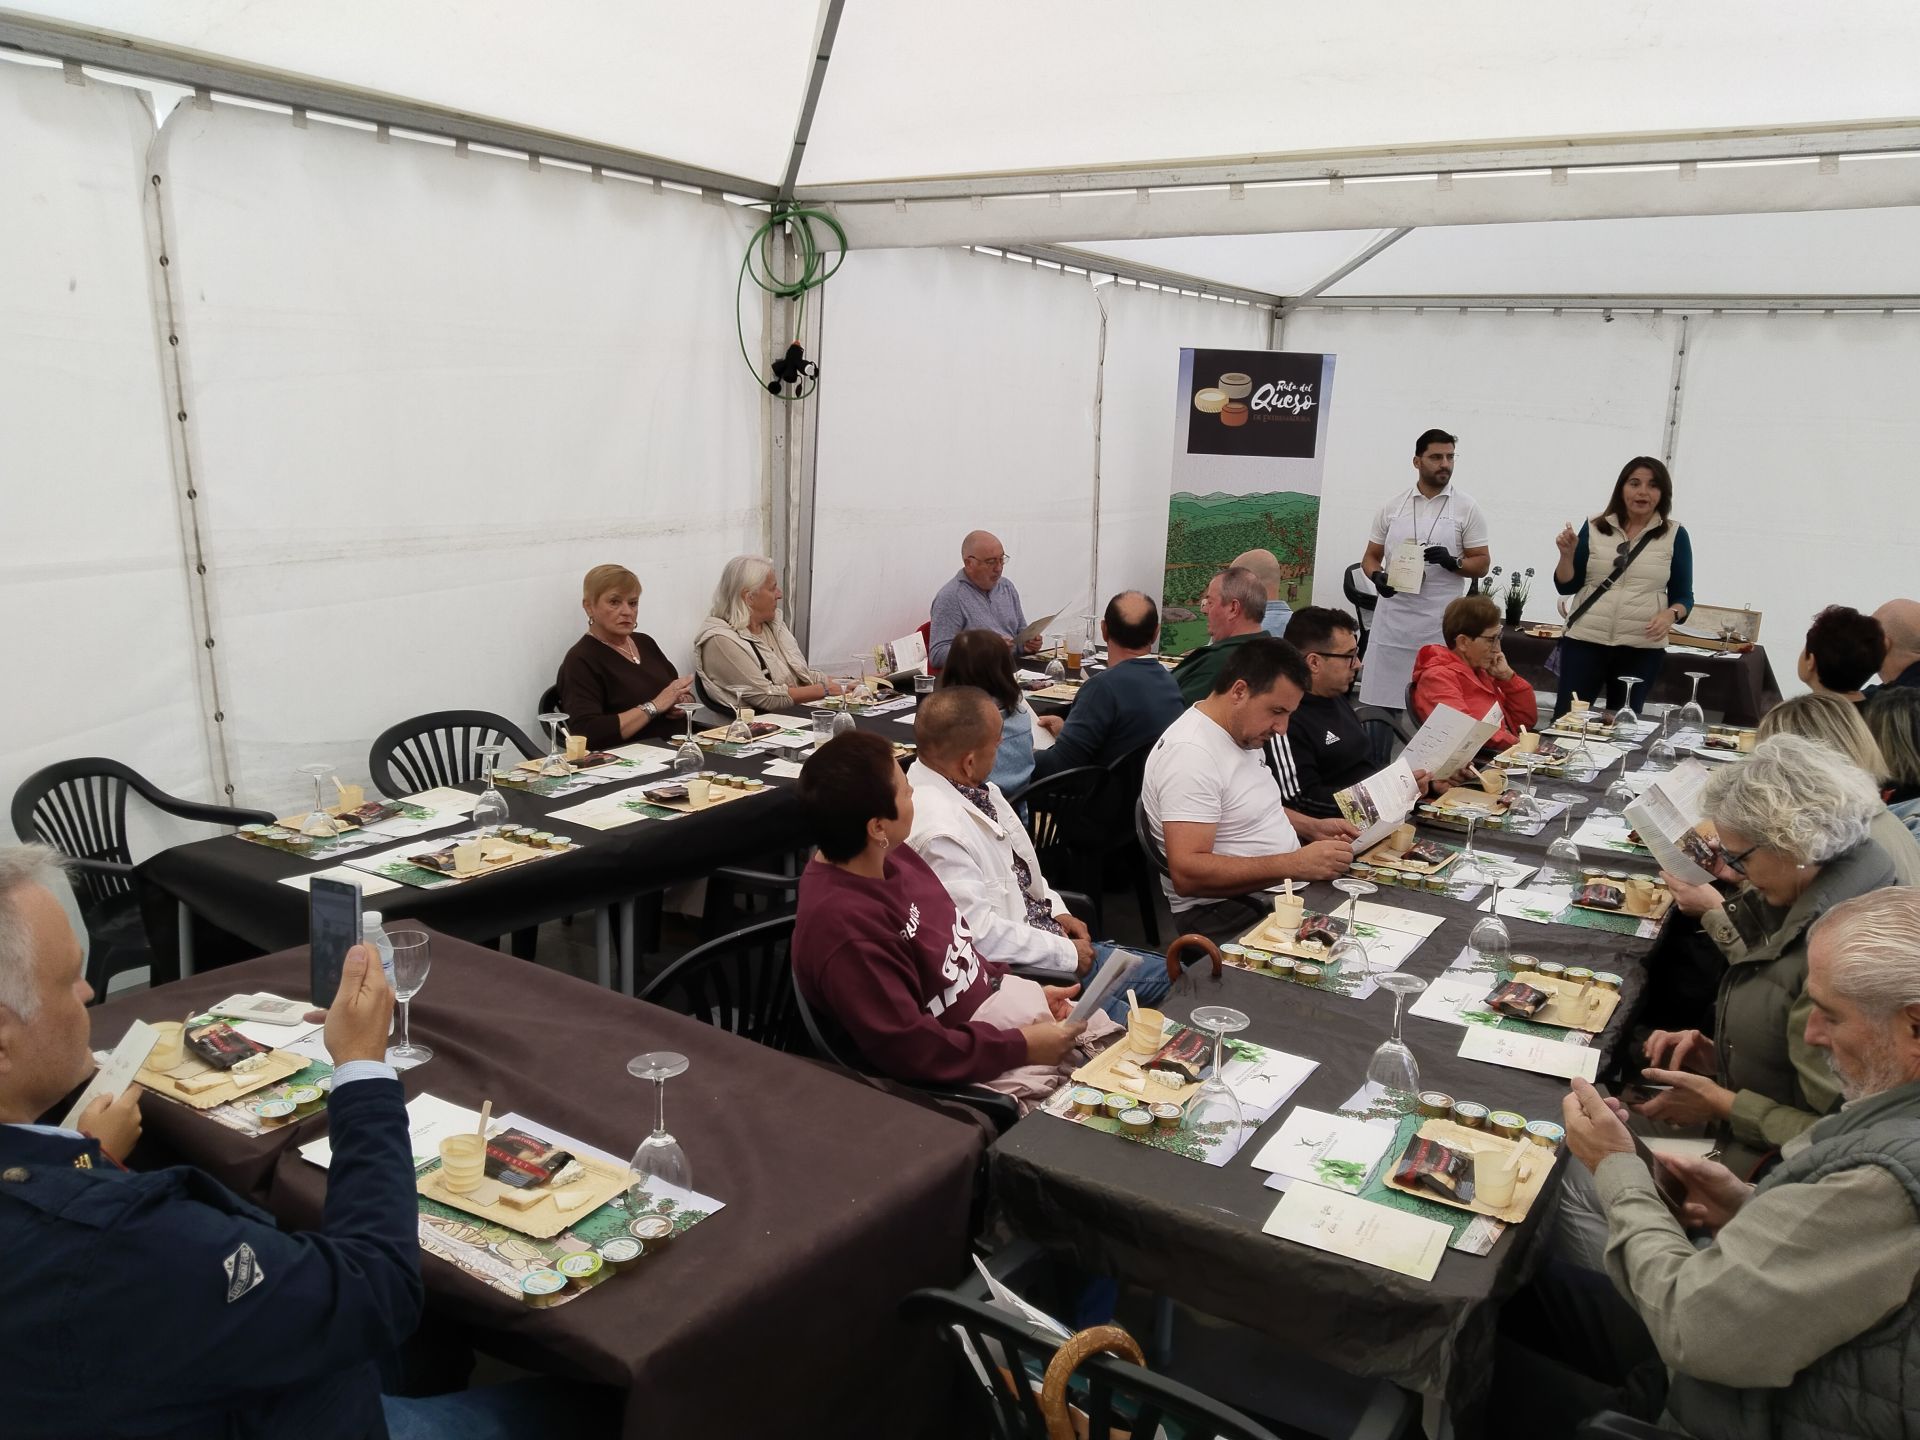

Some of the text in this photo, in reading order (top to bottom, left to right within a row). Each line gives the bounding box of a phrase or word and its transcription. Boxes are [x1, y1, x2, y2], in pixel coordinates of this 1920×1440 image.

[1276, 380, 1313, 393] Ruta del
[1251, 383, 1317, 415] Queso
